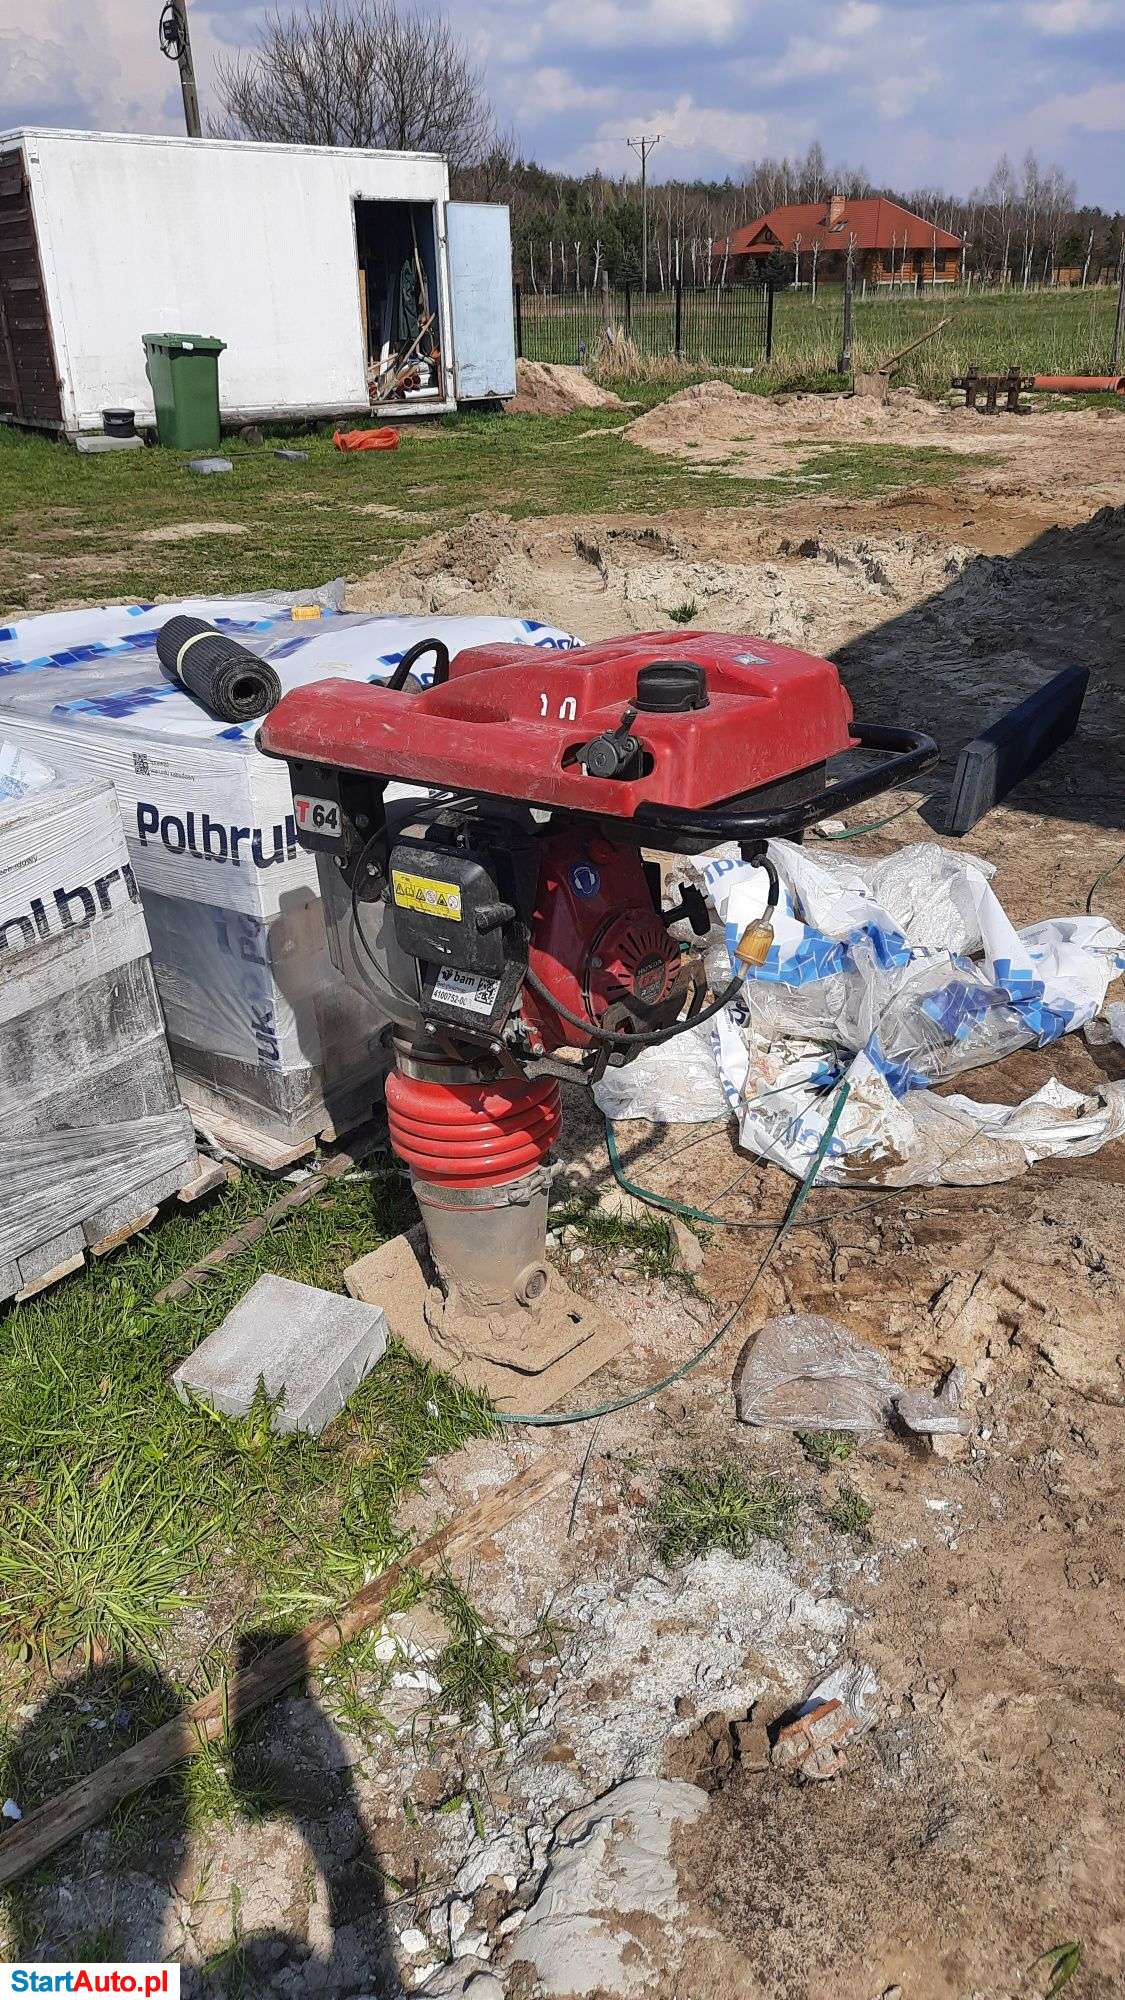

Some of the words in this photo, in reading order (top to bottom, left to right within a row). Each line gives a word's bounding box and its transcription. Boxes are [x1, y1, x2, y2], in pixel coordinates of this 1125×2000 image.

[296, 799, 310, 823] T
[313, 804, 338, 830] 64
[454, 970, 475, 986] bam
